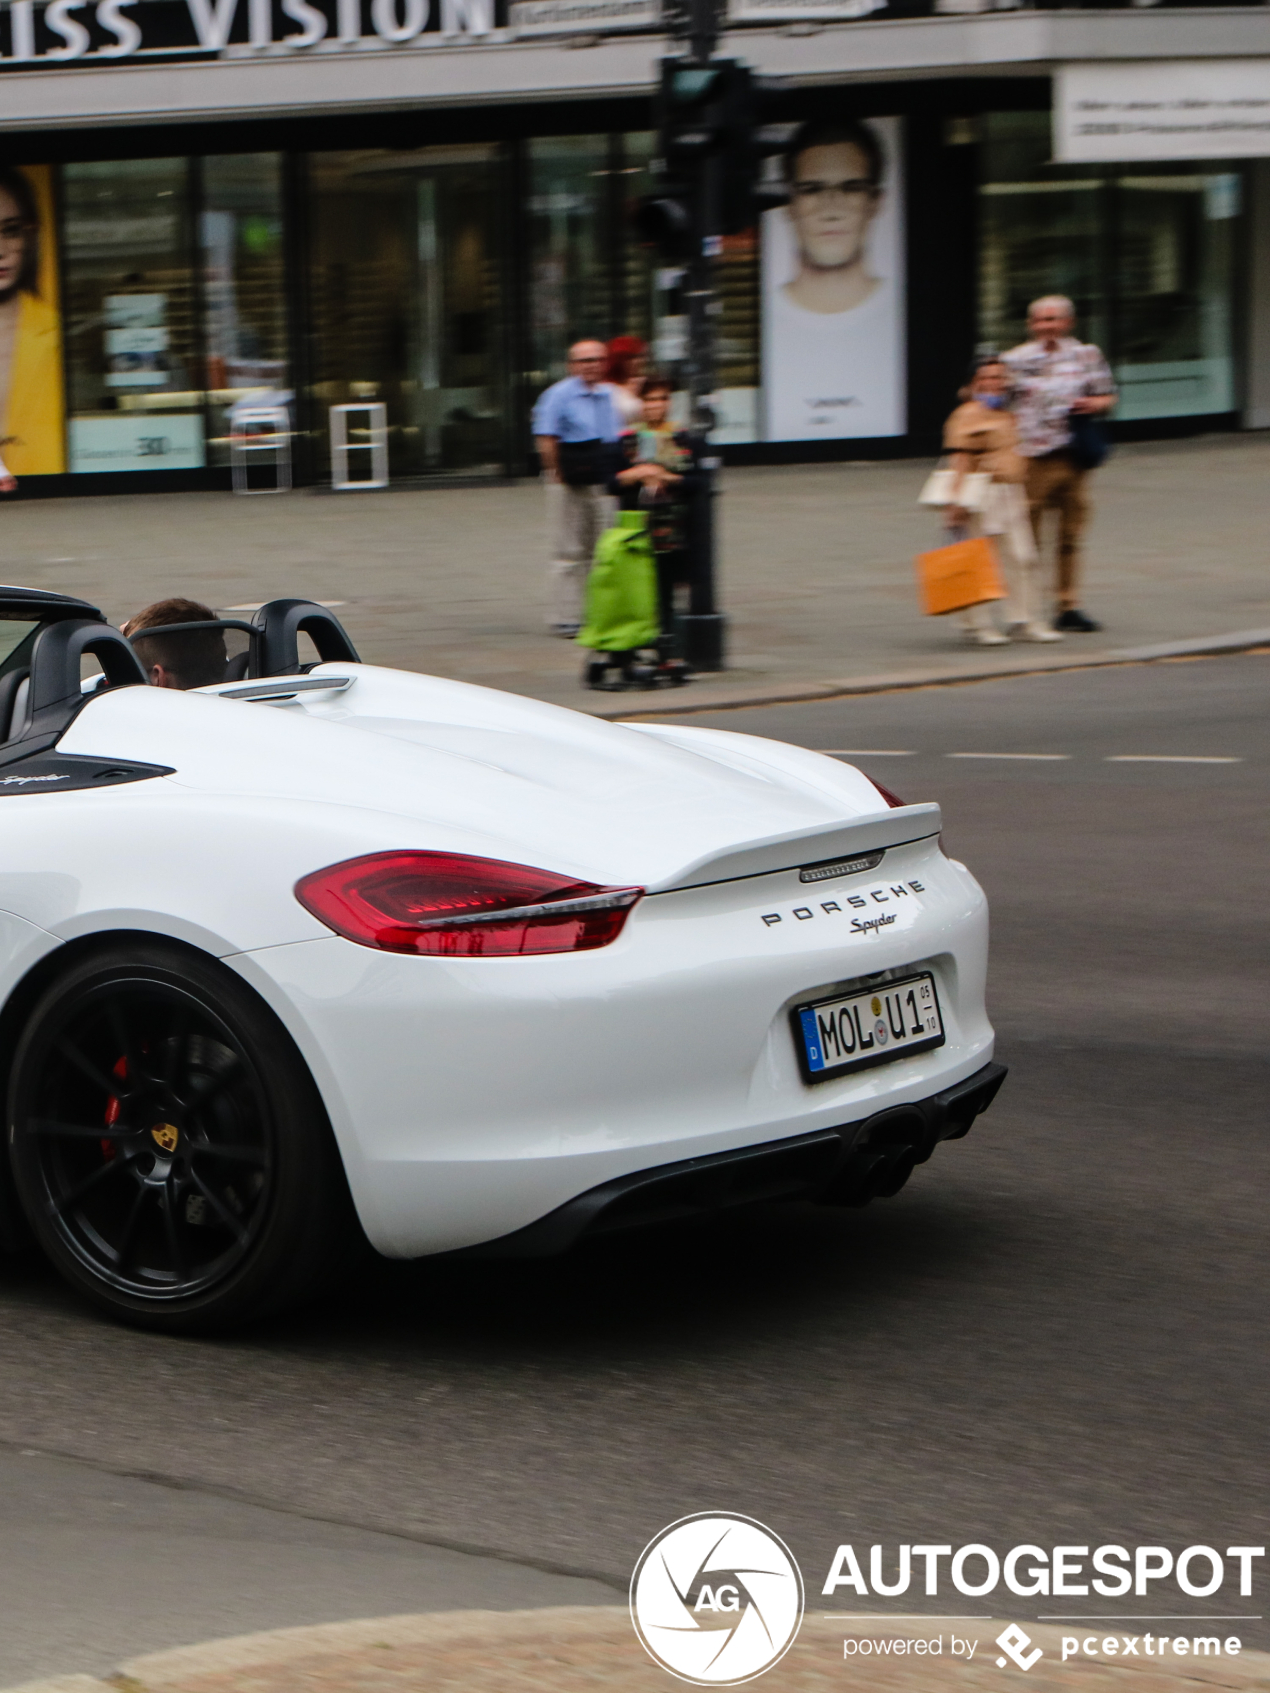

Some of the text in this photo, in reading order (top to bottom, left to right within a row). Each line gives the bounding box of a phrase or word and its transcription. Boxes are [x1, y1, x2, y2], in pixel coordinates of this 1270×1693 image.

[187, 0, 495, 51] VISION
[760, 880, 926, 927] PORSCHE
[849, 912, 898, 935] Spyder
[809, 988, 925, 1061] D MOL U1
